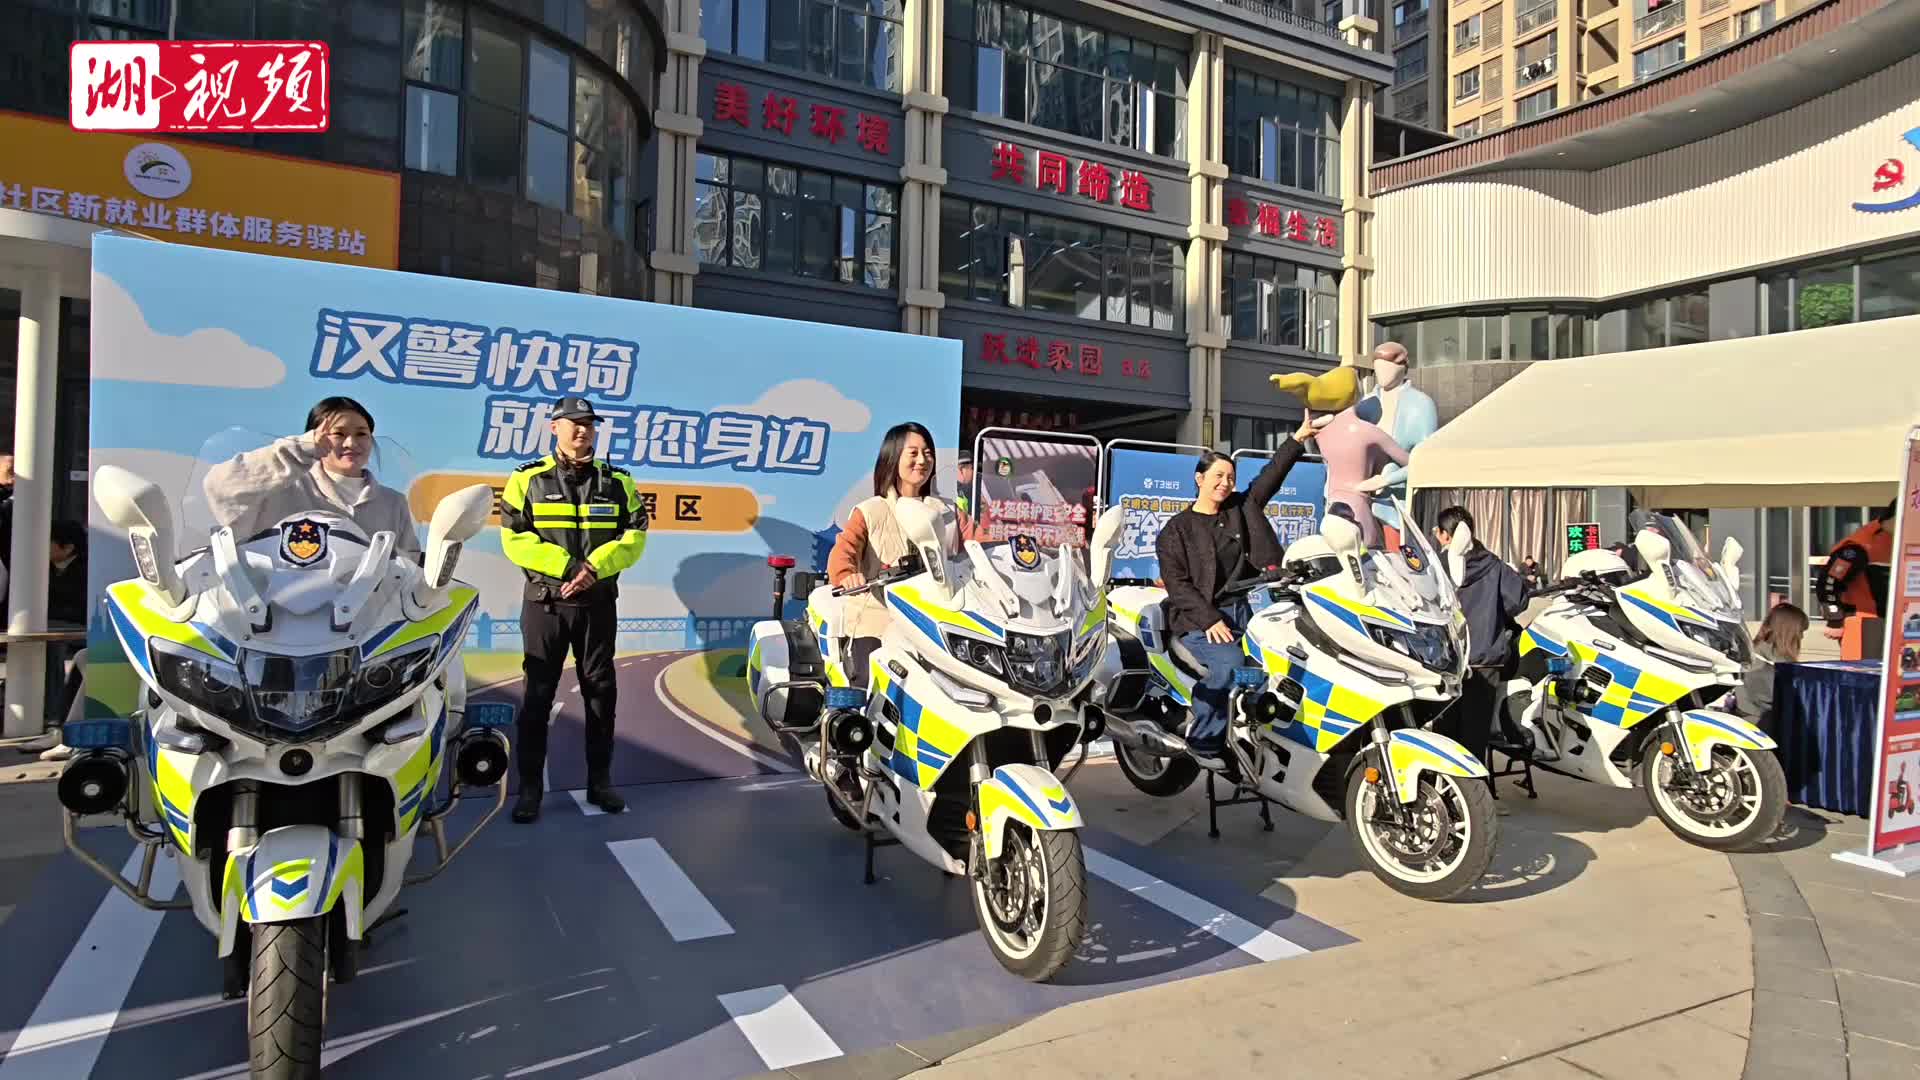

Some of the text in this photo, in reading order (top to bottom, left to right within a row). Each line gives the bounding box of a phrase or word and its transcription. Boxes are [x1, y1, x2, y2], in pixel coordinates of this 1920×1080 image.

[714, 81, 891, 155] 美好环境
[990, 141, 1152, 212] 共同缔造
[0, 181, 367, 256] 社区新就业群体服务驿站
[314, 312, 637, 398] 汉警快骑
[980, 331, 1104, 376] 跃进家园
